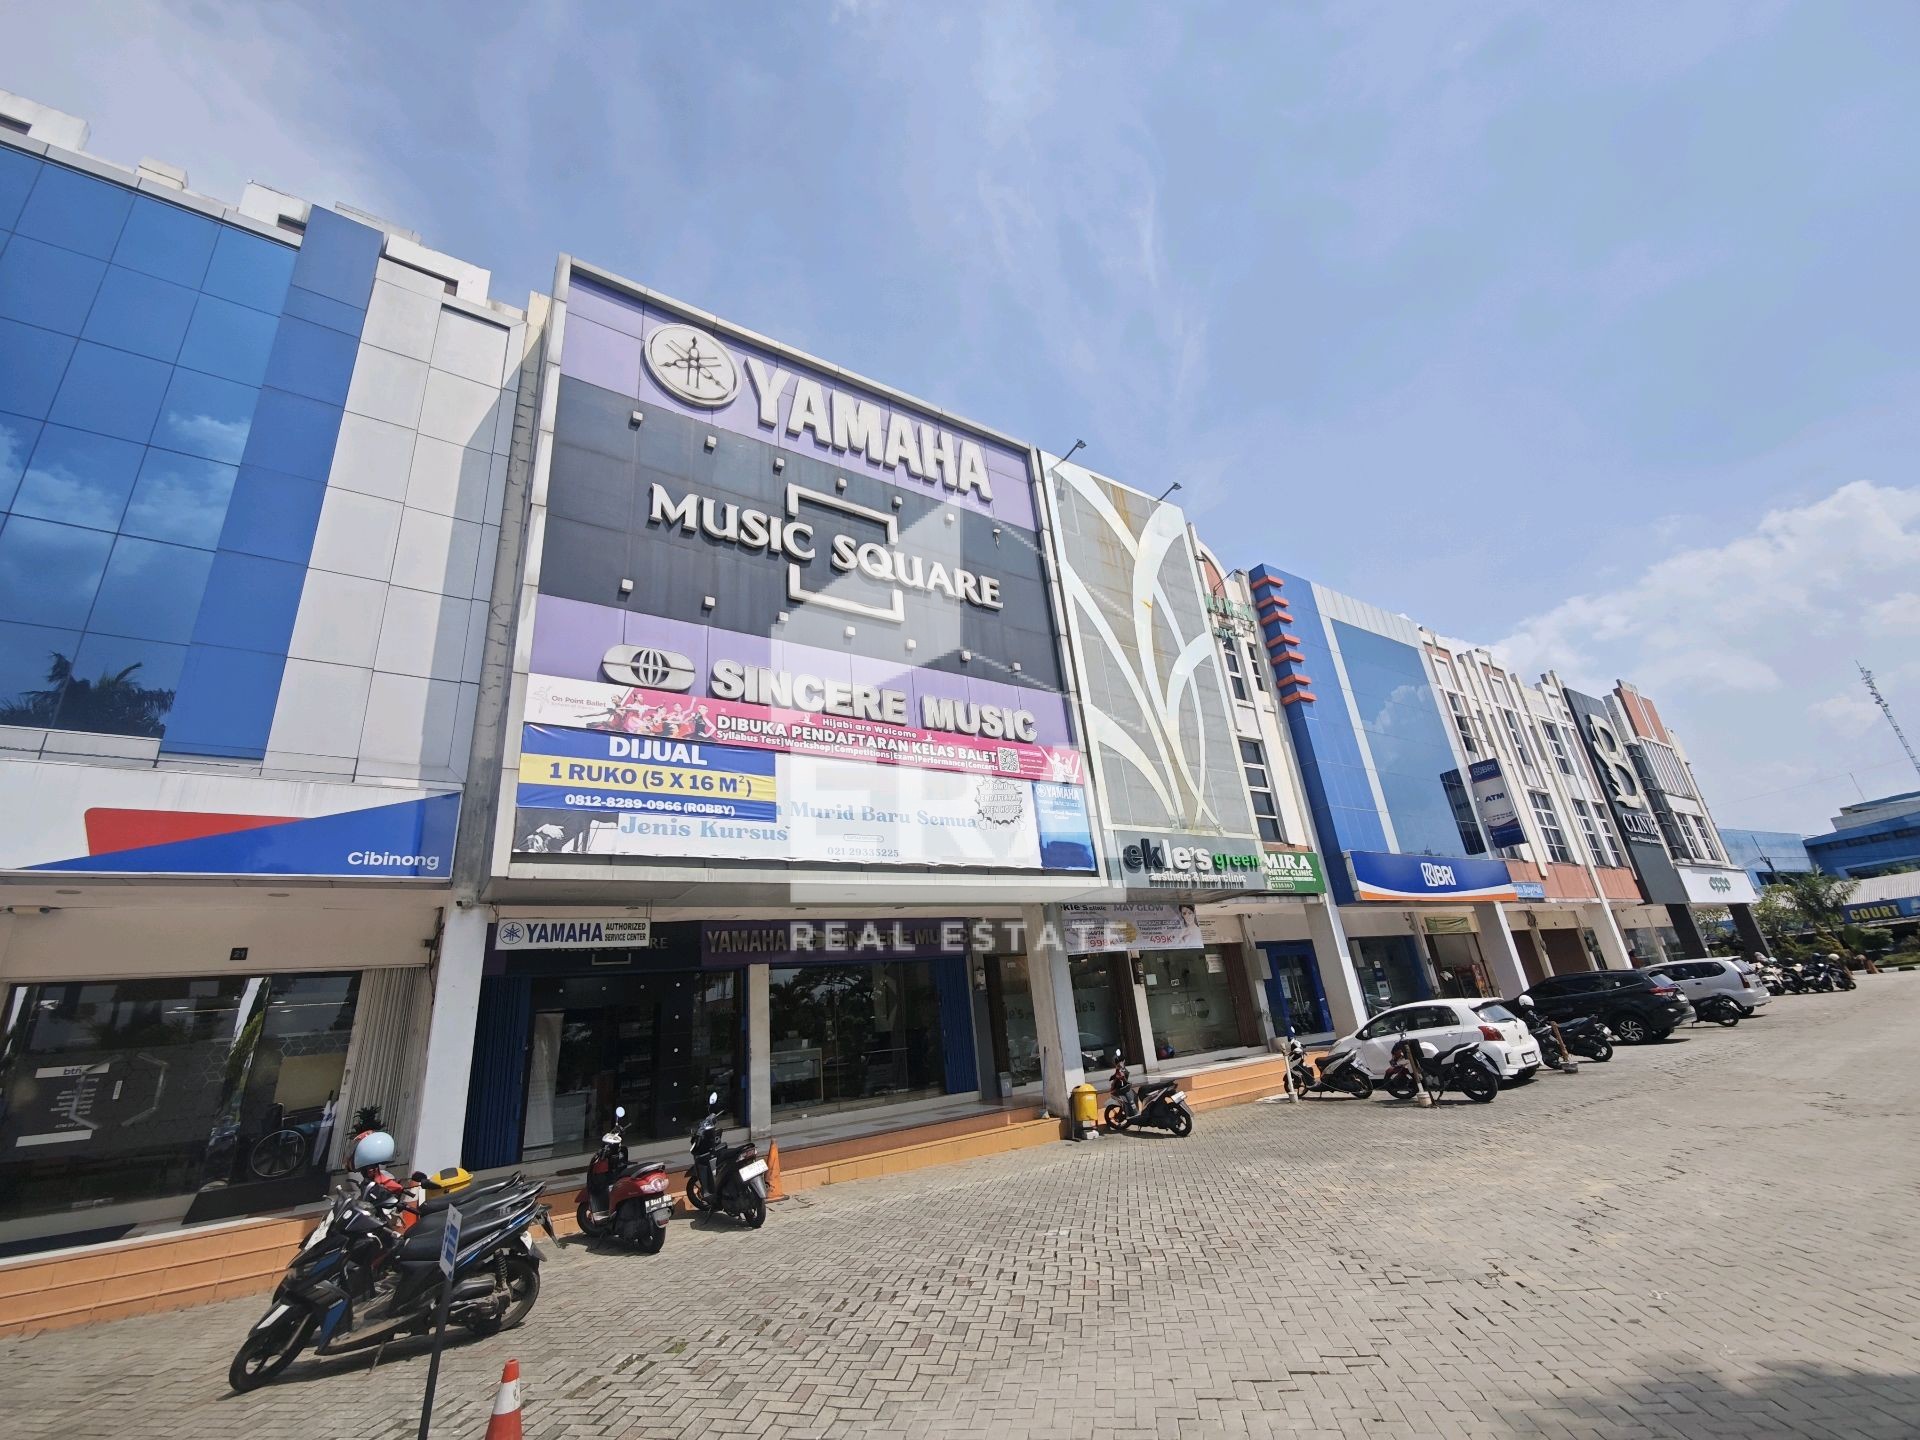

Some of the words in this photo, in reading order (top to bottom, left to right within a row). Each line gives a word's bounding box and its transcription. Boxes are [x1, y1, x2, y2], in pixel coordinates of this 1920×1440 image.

[744, 356, 994, 503] YAMAHA
[648, 482, 816, 562] MUSIC
[831, 533, 1004, 611] SQUARE
[711, 659, 907, 726] SINCERE
[921, 693, 1038, 744] MUSIC
[716, 730, 759, 746] Syllabus
[716, 714, 787, 738] DIBUKA
[791, 725, 909, 754] PENDAFTARAN
[912, 740, 955, 760] KELAS
[958, 747, 998, 764] BALET
[822, 718, 854, 732] Hijabi
[855, 723, 872, 733] are
[874, 725, 917, 739] Welcome
[608, 736, 708, 766] DIJUAL
[549, 762, 562, 779] 1
[569, 764, 638, 786] RUKO
[642, 769, 664, 789] (5
[669, 772, 685, 789] X
[690, 773, 713, 791] 16
[1046, 785, 1080, 801] YAMAHA
[1484, 792, 1505, 803] ATM
[564, 793, 682, 813] 0812-8289-0966
[683, 801, 736, 817] (ROBBY)
[789, 800, 855, 821] Murid
[862, 805, 911, 824] Baru
[916, 810, 978, 829] Semua
[620, 817, 692, 838] Jenis
[700, 820, 788, 842] Kursus
[1623, 813, 1659, 836] CLINIC
[347, 850, 440, 871] Cibinong
[827, 846, 846, 857] 021
[848, 847, 900, 858] 29335225
[1123, 838, 1212, 872] ekle's
[1212, 852, 1260, 871] green
[1057, 903, 1089, 912] kle's
[1848, 904, 1900, 921] COURT
[526, 921, 604, 944] YAMAHA
[604, 922, 647, 932] AUTHORIZED
[604, 932, 627, 942] SERVICE
[627, 931, 647, 941] CENTER
[707, 930, 788, 954] YAMAHA
